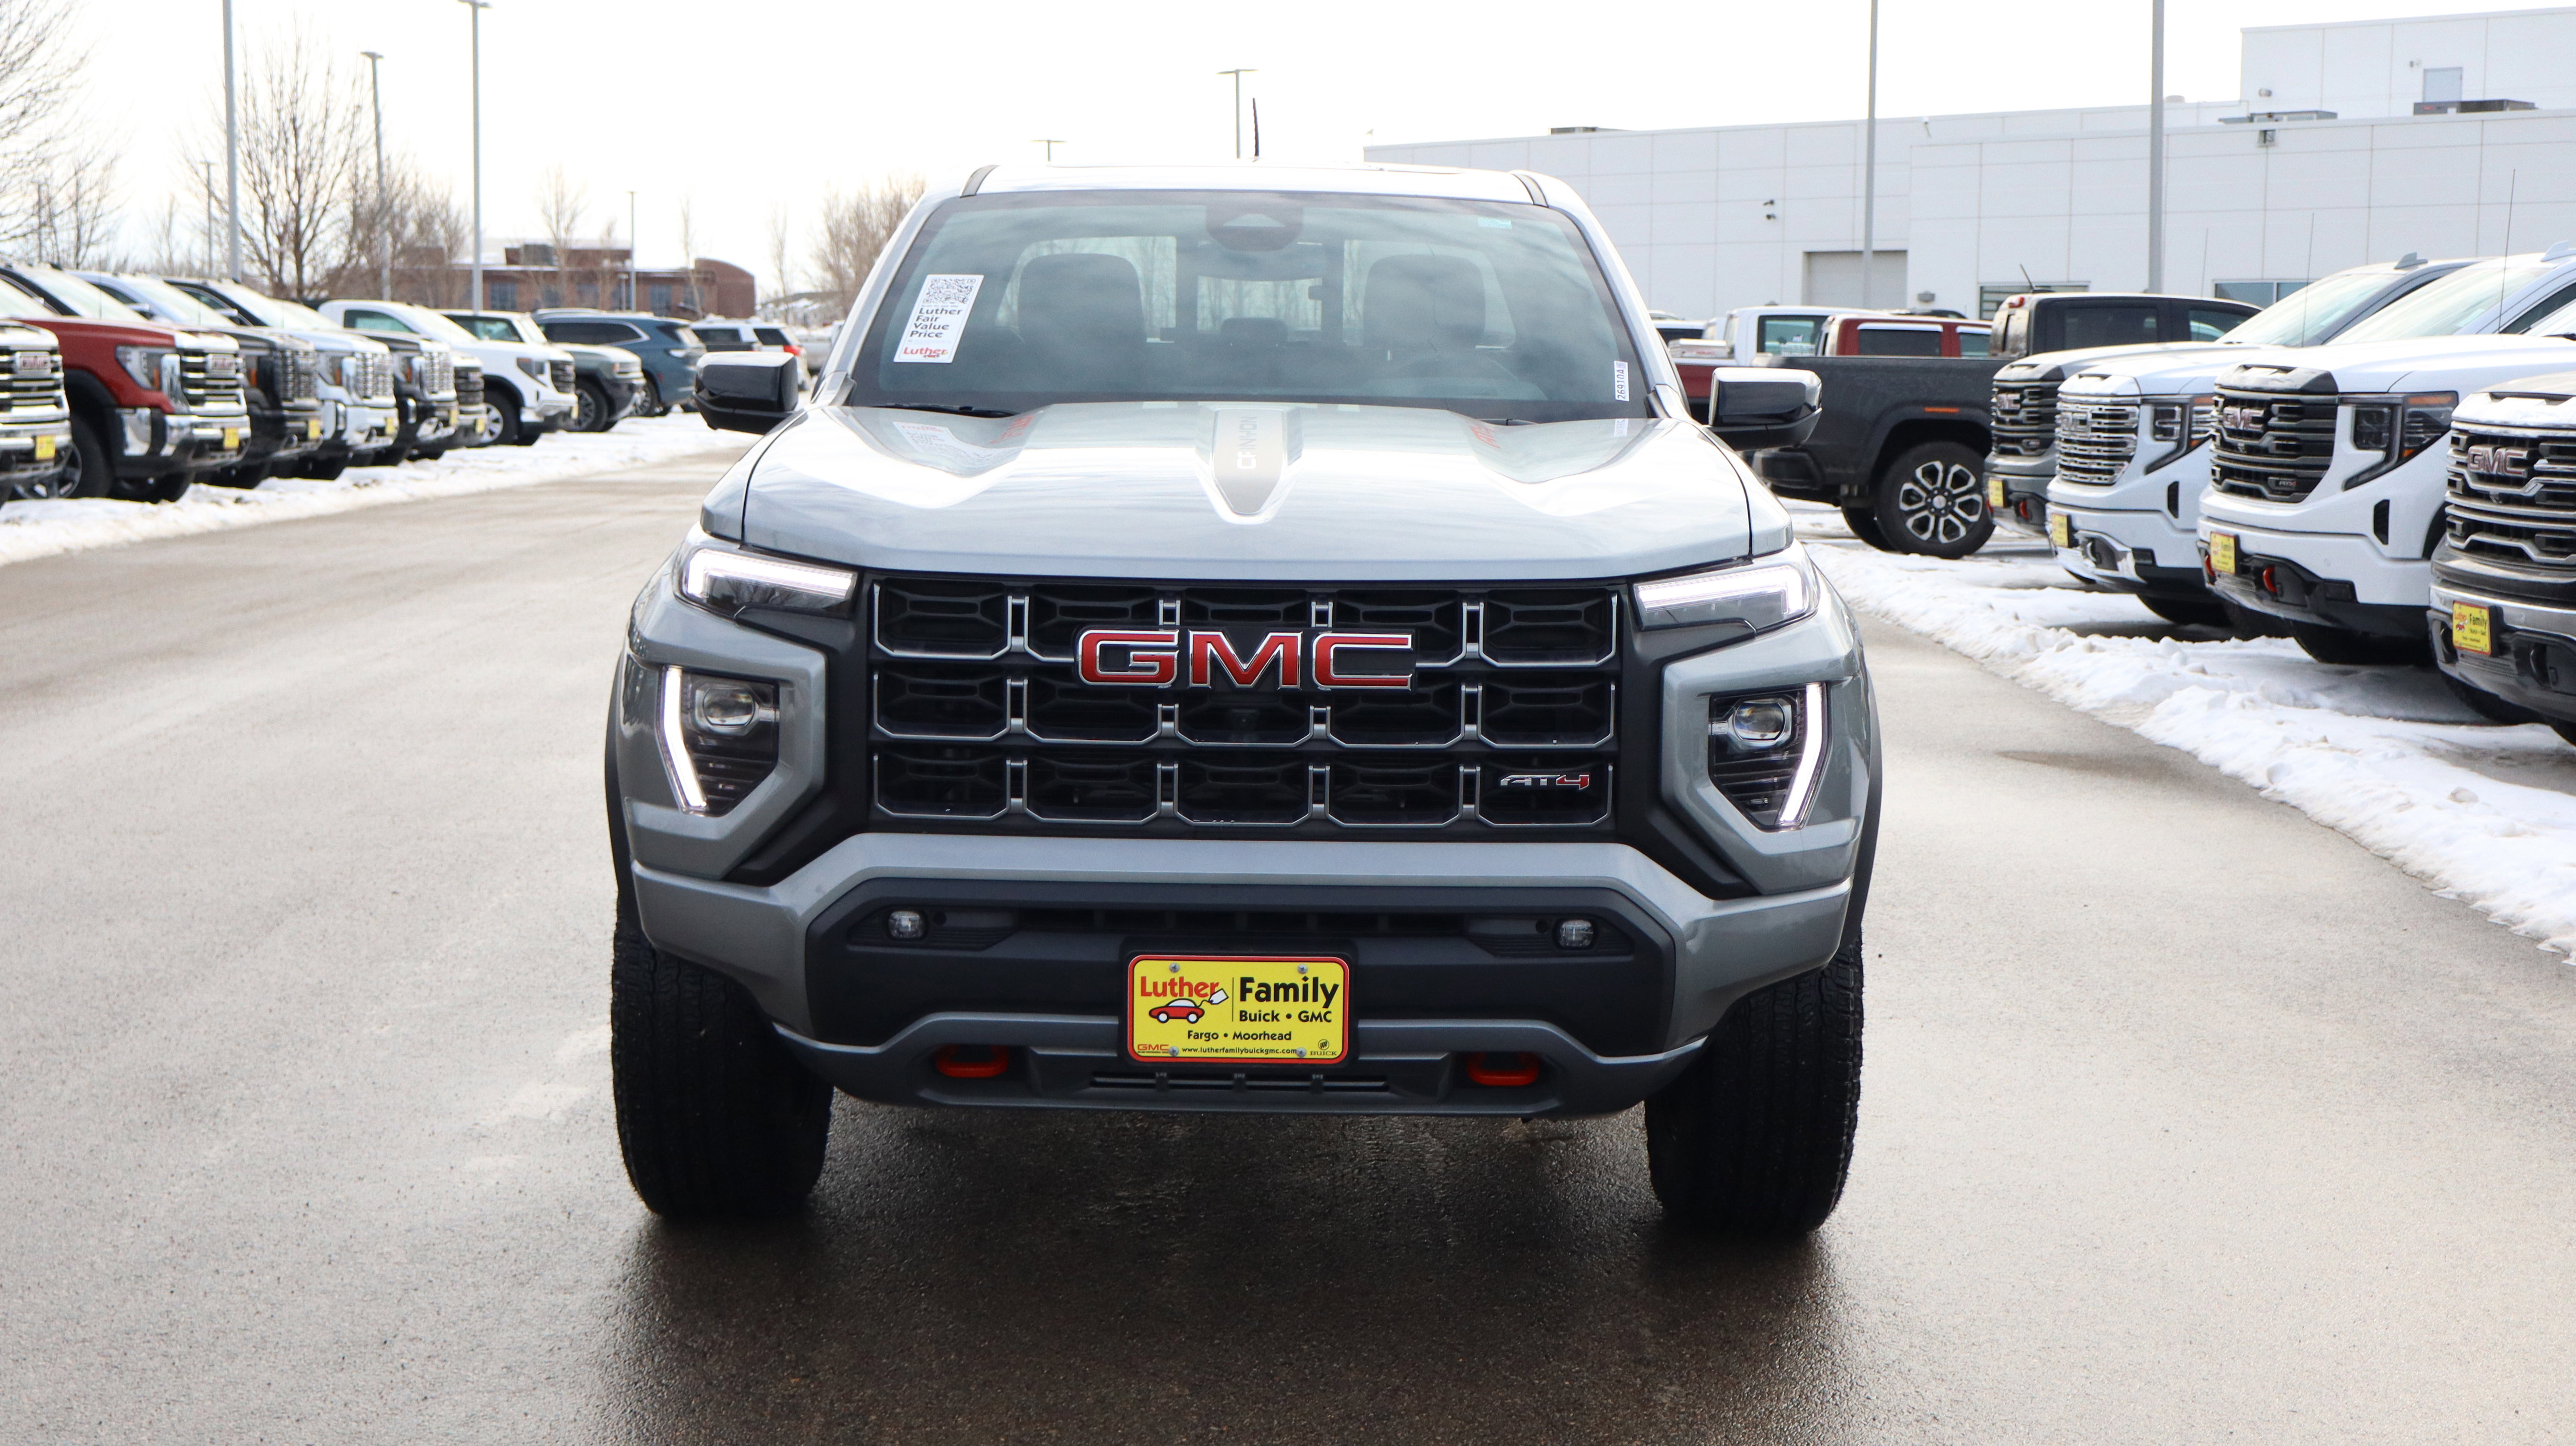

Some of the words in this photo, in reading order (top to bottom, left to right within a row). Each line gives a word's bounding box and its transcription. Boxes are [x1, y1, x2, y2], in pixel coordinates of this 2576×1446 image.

[1616, 369, 1626, 399] 26910A
[1237, 415, 1257, 469] CANYON
[2468, 446, 2528, 478] GMC
[1077, 629, 1413, 691] GMC
[1500, 774, 1590, 790] AT4
[1140, 976, 1220, 998] Luther
[1240, 975, 1339, 1009] Family
[1239, 1009, 1280, 1022] Buick
[1298, 1010, 1332, 1022] GMC
[1187, 1030, 1219, 1041] Fargo
[1233, 1030, 1292, 1040] Moorhead
